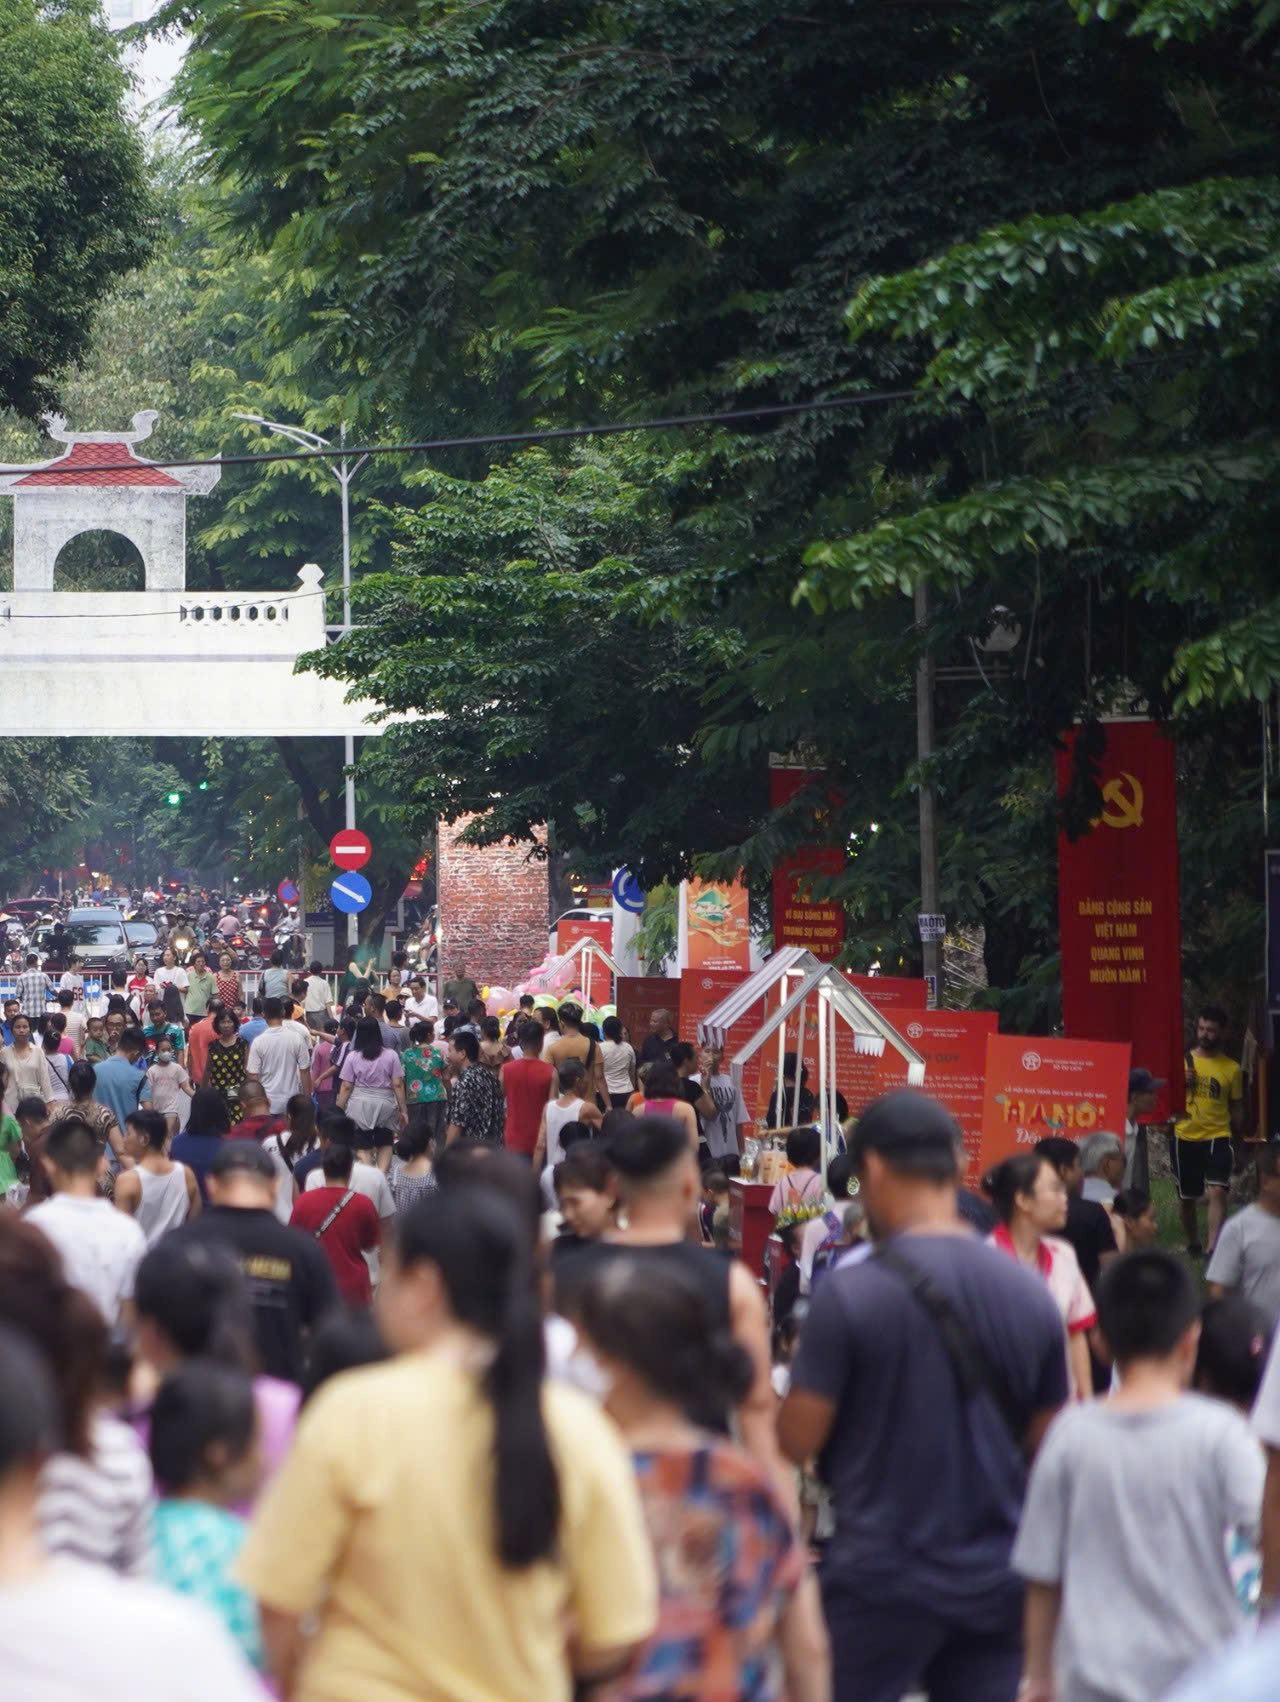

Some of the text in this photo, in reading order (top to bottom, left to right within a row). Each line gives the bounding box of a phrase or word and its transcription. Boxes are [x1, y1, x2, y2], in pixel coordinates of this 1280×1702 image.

[1079, 897, 1152, 918] ĐẢNG CỘNG SẢN
[1095, 921, 1137, 940] VIỆT NAM
[1091, 946, 1144, 962] QUANG VINH
[1090, 966, 1117, 983] MUÔN
[1119, 966, 1140, 983] NĂM
